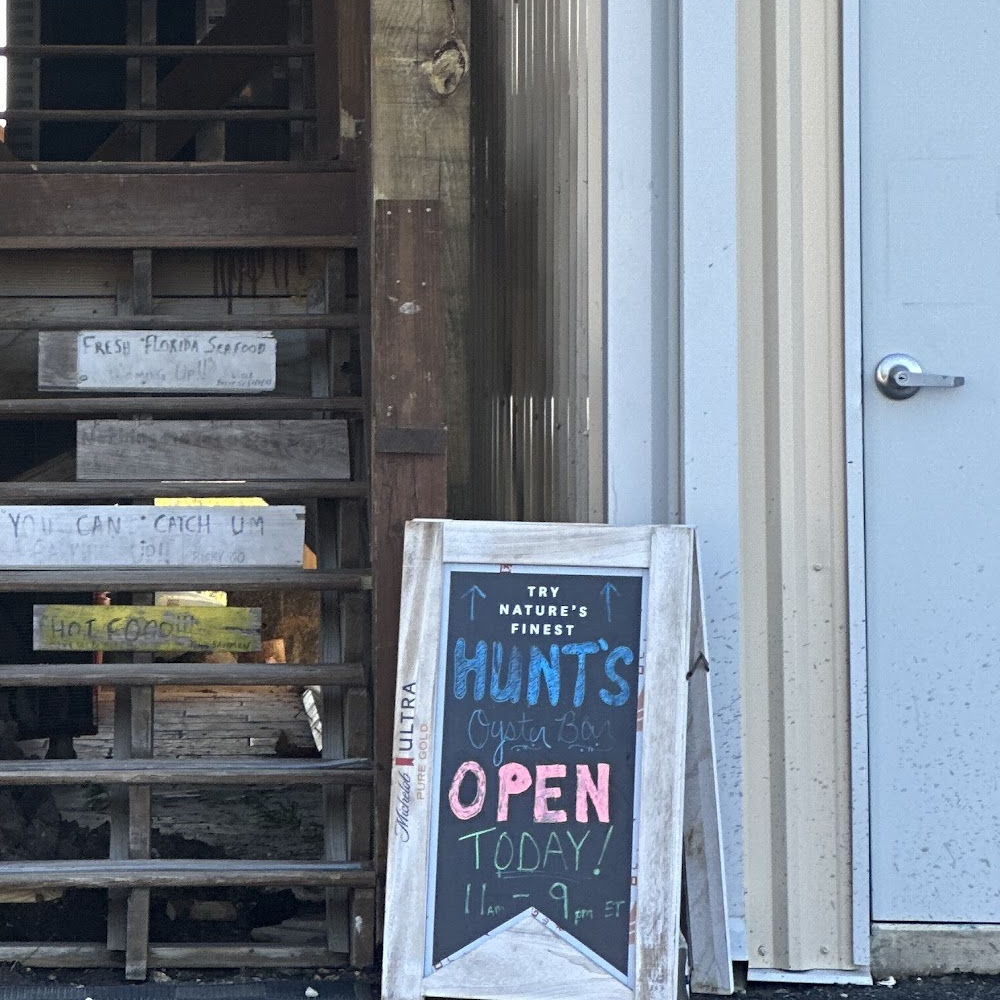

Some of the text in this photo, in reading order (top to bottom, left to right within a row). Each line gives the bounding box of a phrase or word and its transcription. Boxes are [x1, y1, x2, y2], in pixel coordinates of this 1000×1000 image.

[83, 336, 130, 355] FRESH
[144, 335, 199, 355] FLORIDA
[76, 514, 121, 536] CAN
[154, 514, 211, 535] CATCH
[527, 585, 560, 598] TRY
[499, 603, 588, 618] NATURE'S
[511, 622, 575, 636] FINEST
[453, 637, 635, 708] HUNT'S
[394, 681, 417, 844] Michelob ULTRA
[416, 722, 429, 800] PURE GOLD
[448, 760, 610, 824] OPEN
[458, 825, 614, 877] TODAY!
